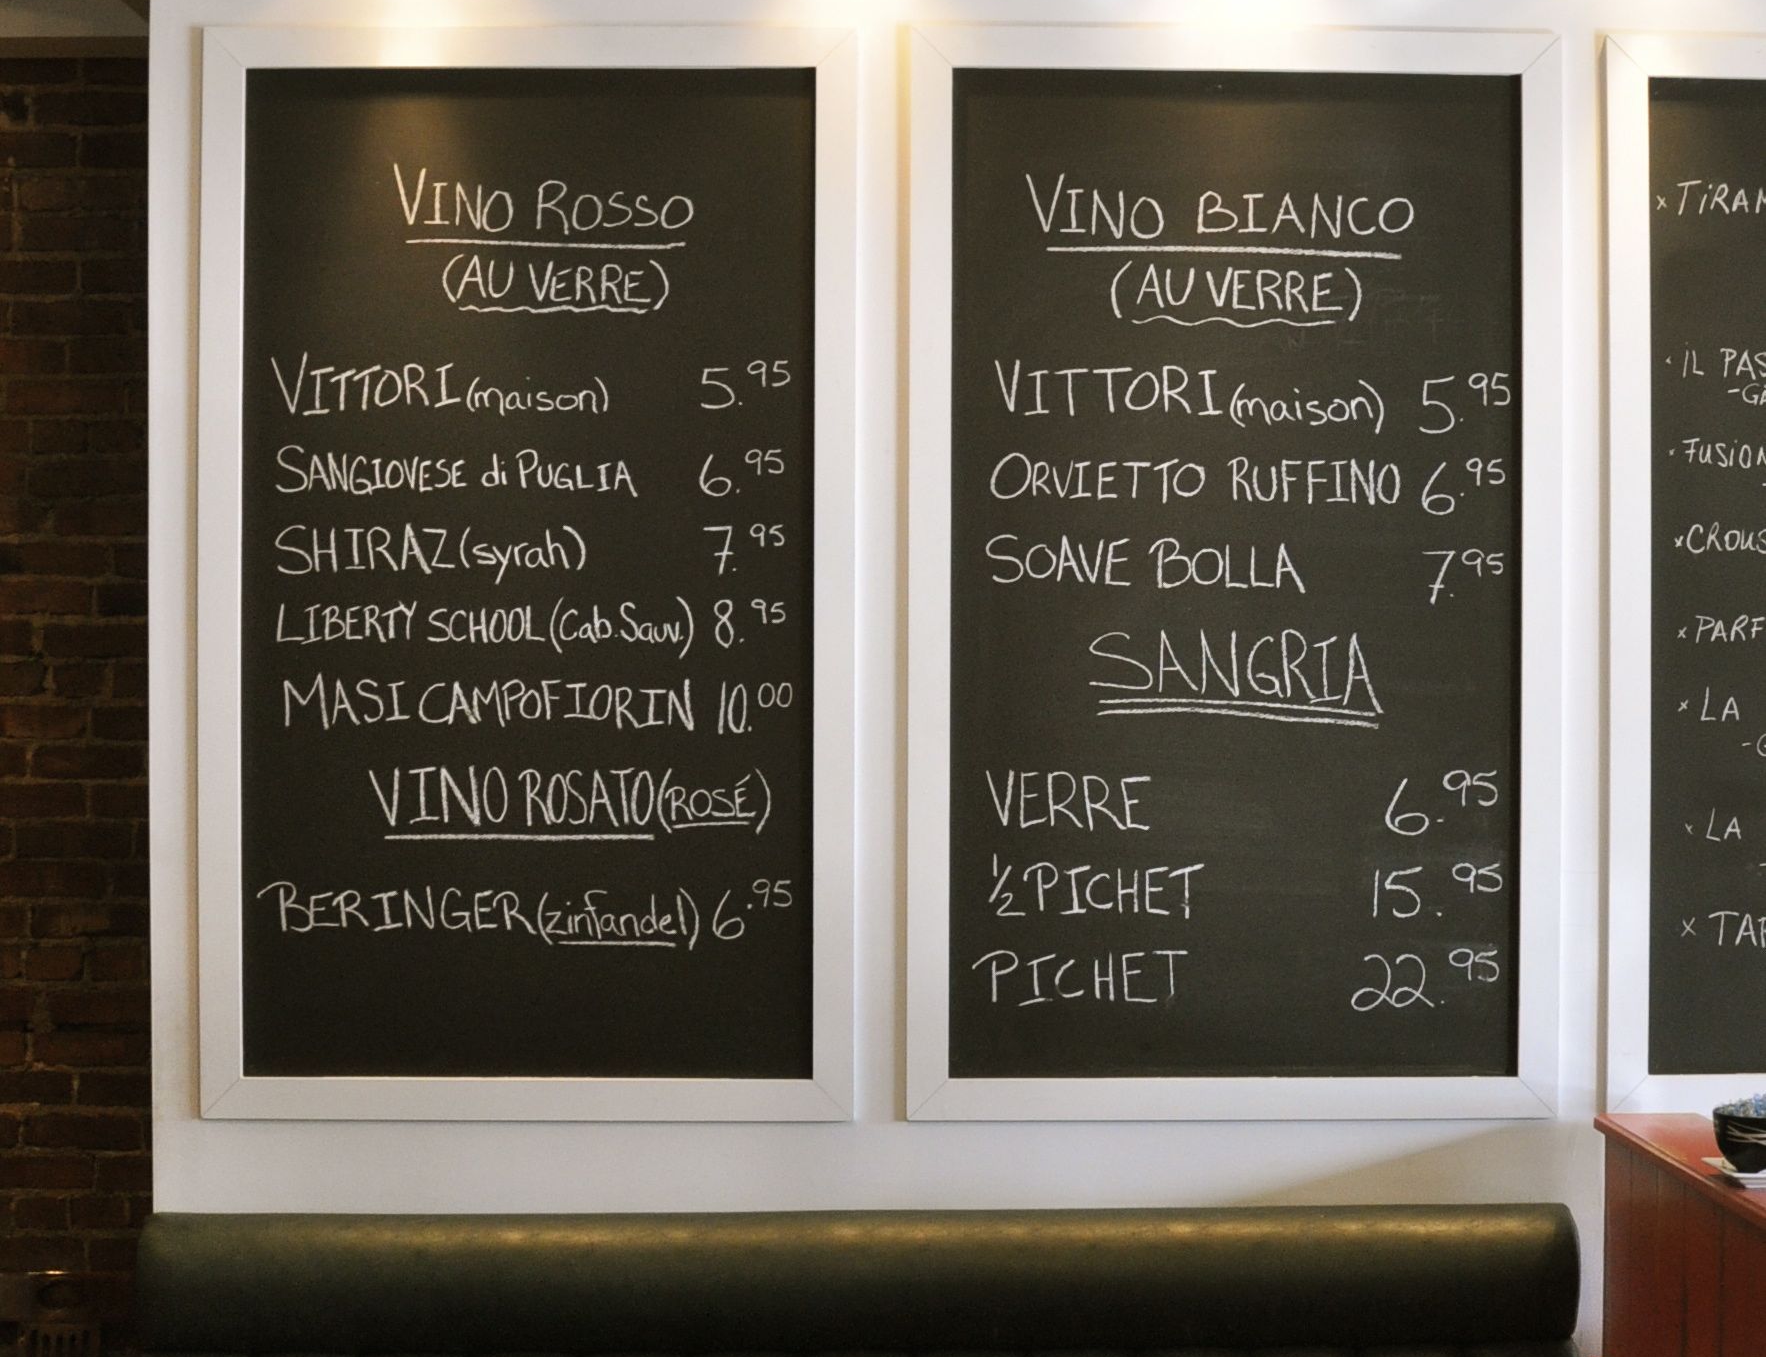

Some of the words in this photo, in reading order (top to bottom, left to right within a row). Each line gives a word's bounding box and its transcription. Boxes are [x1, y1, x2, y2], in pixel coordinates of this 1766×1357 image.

[394, 163, 513, 234] VINO
[536, 180, 694, 234] ROSSO
[1025, 173, 1165, 239] VINO
[1197, 191, 1415, 238] BIANCO
[443, 254, 514, 303] (AU
[529, 259, 669, 310] VERRE)
[1110, 261, 1196, 318] (AU
[1206, 266, 1362, 322] VERRE)
[271, 352, 461, 415] VITTORI
[466, 376, 609, 416] (maison)
[700, 360, 791, 409] 5.95
[994, 360, 1224, 416] VITTORI
[1229, 379, 1384, 434] (maison)
[1419, 372, 1511, 434] 5.95
[275, 445, 466, 495] SANGIOVESE
[482, 455, 507, 487] di
[515, 449, 638, 497] PUGLIA
[699, 449, 785, 497] 6.95
[990, 453, 1206, 503] ORVIETTO
[1227, 457, 1401, 505] RUFFINO
[1421, 458, 1506, 515] 6.95
[275, 523, 457, 574] SHIRAZ
[459, 526, 586, 585] (syrah)
[703, 524, 786, 576] 7.95
[985, 534, 1131, 587] SOAVE
[1149, 538, 1306, 594] BOLLA
[1423, 549, 1504, 604] 7.95
[276, 601, 417, 645] LIBERTY
[427, 604, 546, 644] SCHOOL
[713, 599, 787, 649] 8.95
[282, 673, 411, 730] MASI
[418, 678, 695, 731] CAMPOFIORIN
[717, 681, 793, 734] 10.00
[1089, 630, 1384, 715] SANGRIA
[1700, 685, 1740, 722] LA
[369, 765, 508, 827] VINO
[518, 768, 655, 828] ROSATO
[986, 769, 1151, 831] VERRE
[1384, 769, 1499, 835] 6.95
[1705, 807, 1742, 842] LA
[257, 881, 536, 935] BERINGER
[1023, 862, 1205, 919] PICHET
[1371, 862, 1503, 918] 15.95
[972, 950, 1188, 1006] PICHET
[1351, 947, 1500, 1011] 22.95
